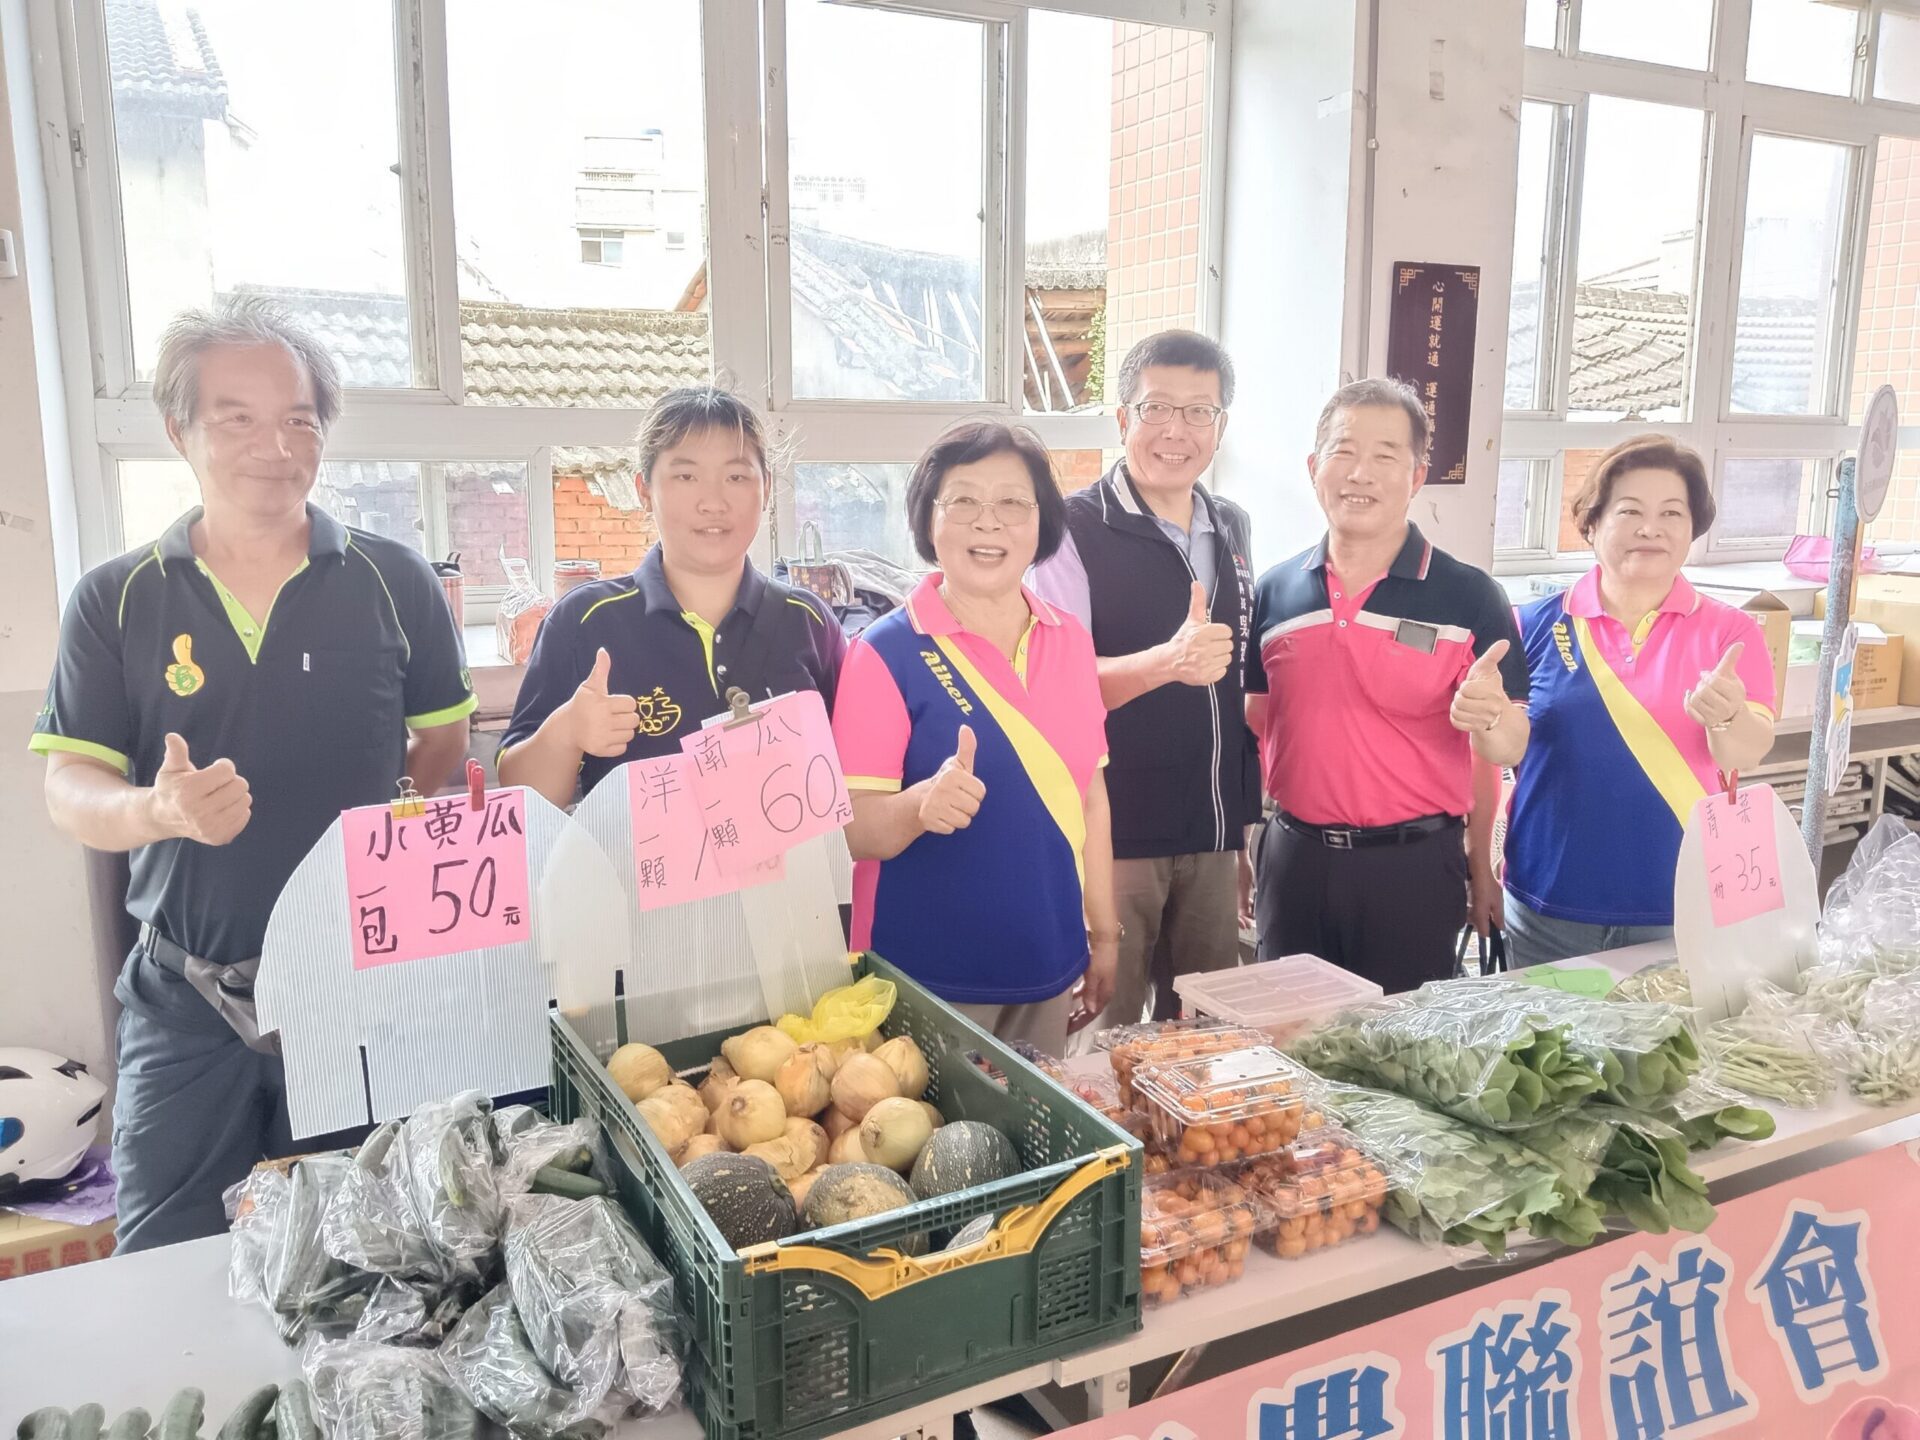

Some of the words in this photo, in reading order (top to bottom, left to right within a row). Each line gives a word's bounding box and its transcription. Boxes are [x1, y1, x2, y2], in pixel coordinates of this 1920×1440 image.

[1426, 281, 1446, 368] 心開運就通
[919, 651, 973, 716] Aiken
[693, 708, 802, 777] 南瓜
[640, 762, 682, 814] 洋
[1705, 792, 1753, 839] 青菜
[366, 793, 522, 862] 小黃瓜
[704, 799, 740, 849] 一顆
[639, 833, 668, 889] 一顆
[356, 885, 398, 955] 一包
